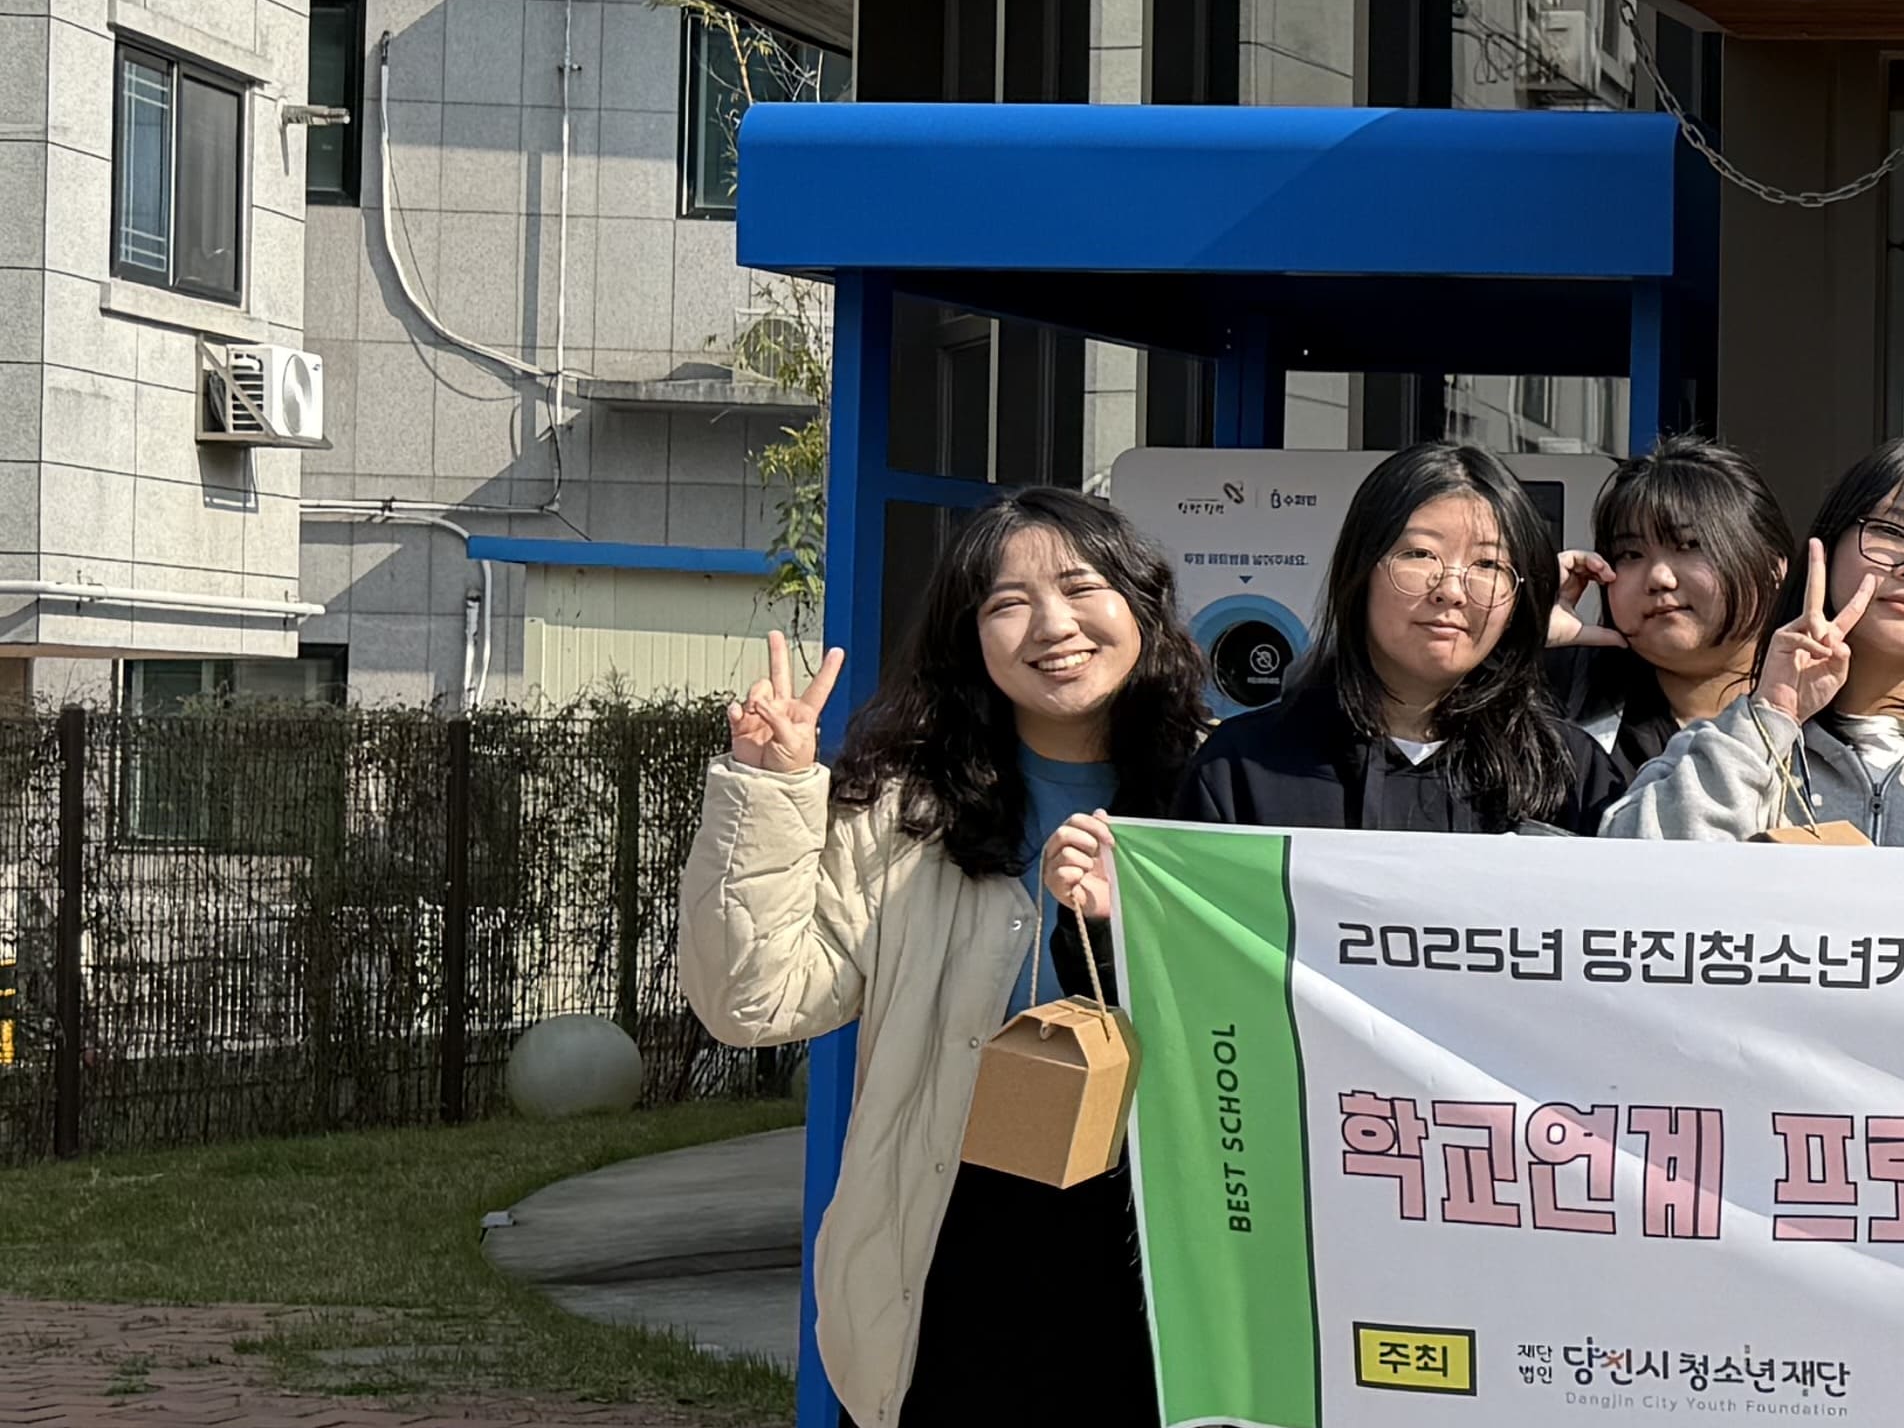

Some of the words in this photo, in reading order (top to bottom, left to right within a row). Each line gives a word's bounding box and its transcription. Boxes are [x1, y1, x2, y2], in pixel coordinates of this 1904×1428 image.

[1338, 921, 1564, 981] 2025년
[1211, 1024, 1245, 1152] SCHOOL
[1338, 1089, 1725, 1244] 학교연계
[1223, 1162, 1252, 1233] BEST
[1377, 1342, 1450, 1379] 주최
[1517, 1343, 1553, 1363] 재단
[1518, 1364, 1553, 1385] 법인
[1565, 1392, 1634, 1410] Dangjin
[1642, 1395, 1678, 1412] City
[1686, 1397, 1737, 1413] Youth
[1746, 1400, 1848, 1417] Foundation
